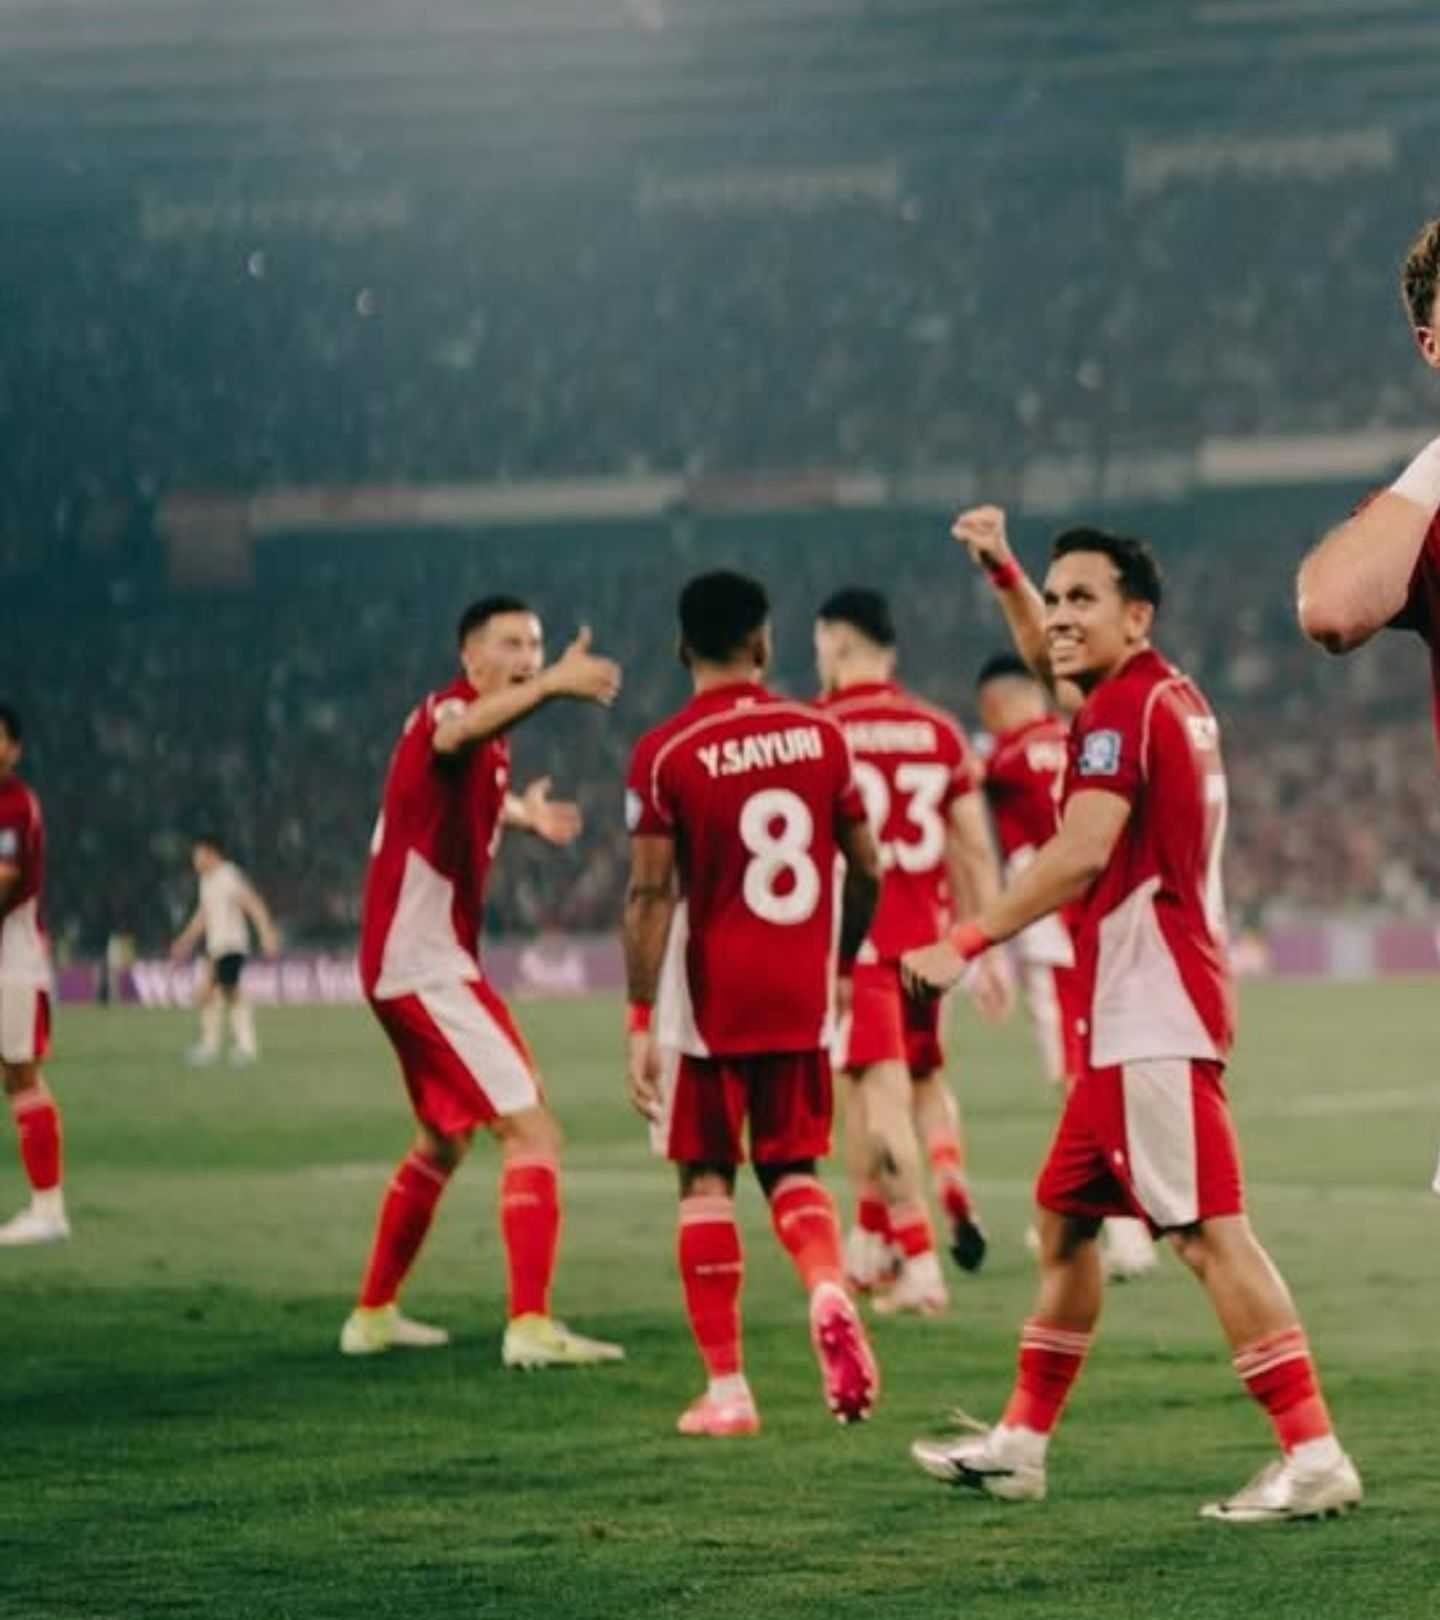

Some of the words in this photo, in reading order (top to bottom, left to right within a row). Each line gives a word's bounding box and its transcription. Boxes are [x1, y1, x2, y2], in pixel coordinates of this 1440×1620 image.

[697, 726, 823, 778] Y.SAYURI
[739, 787, 820, 925] 8
[850, 760, 949, 873] 23
